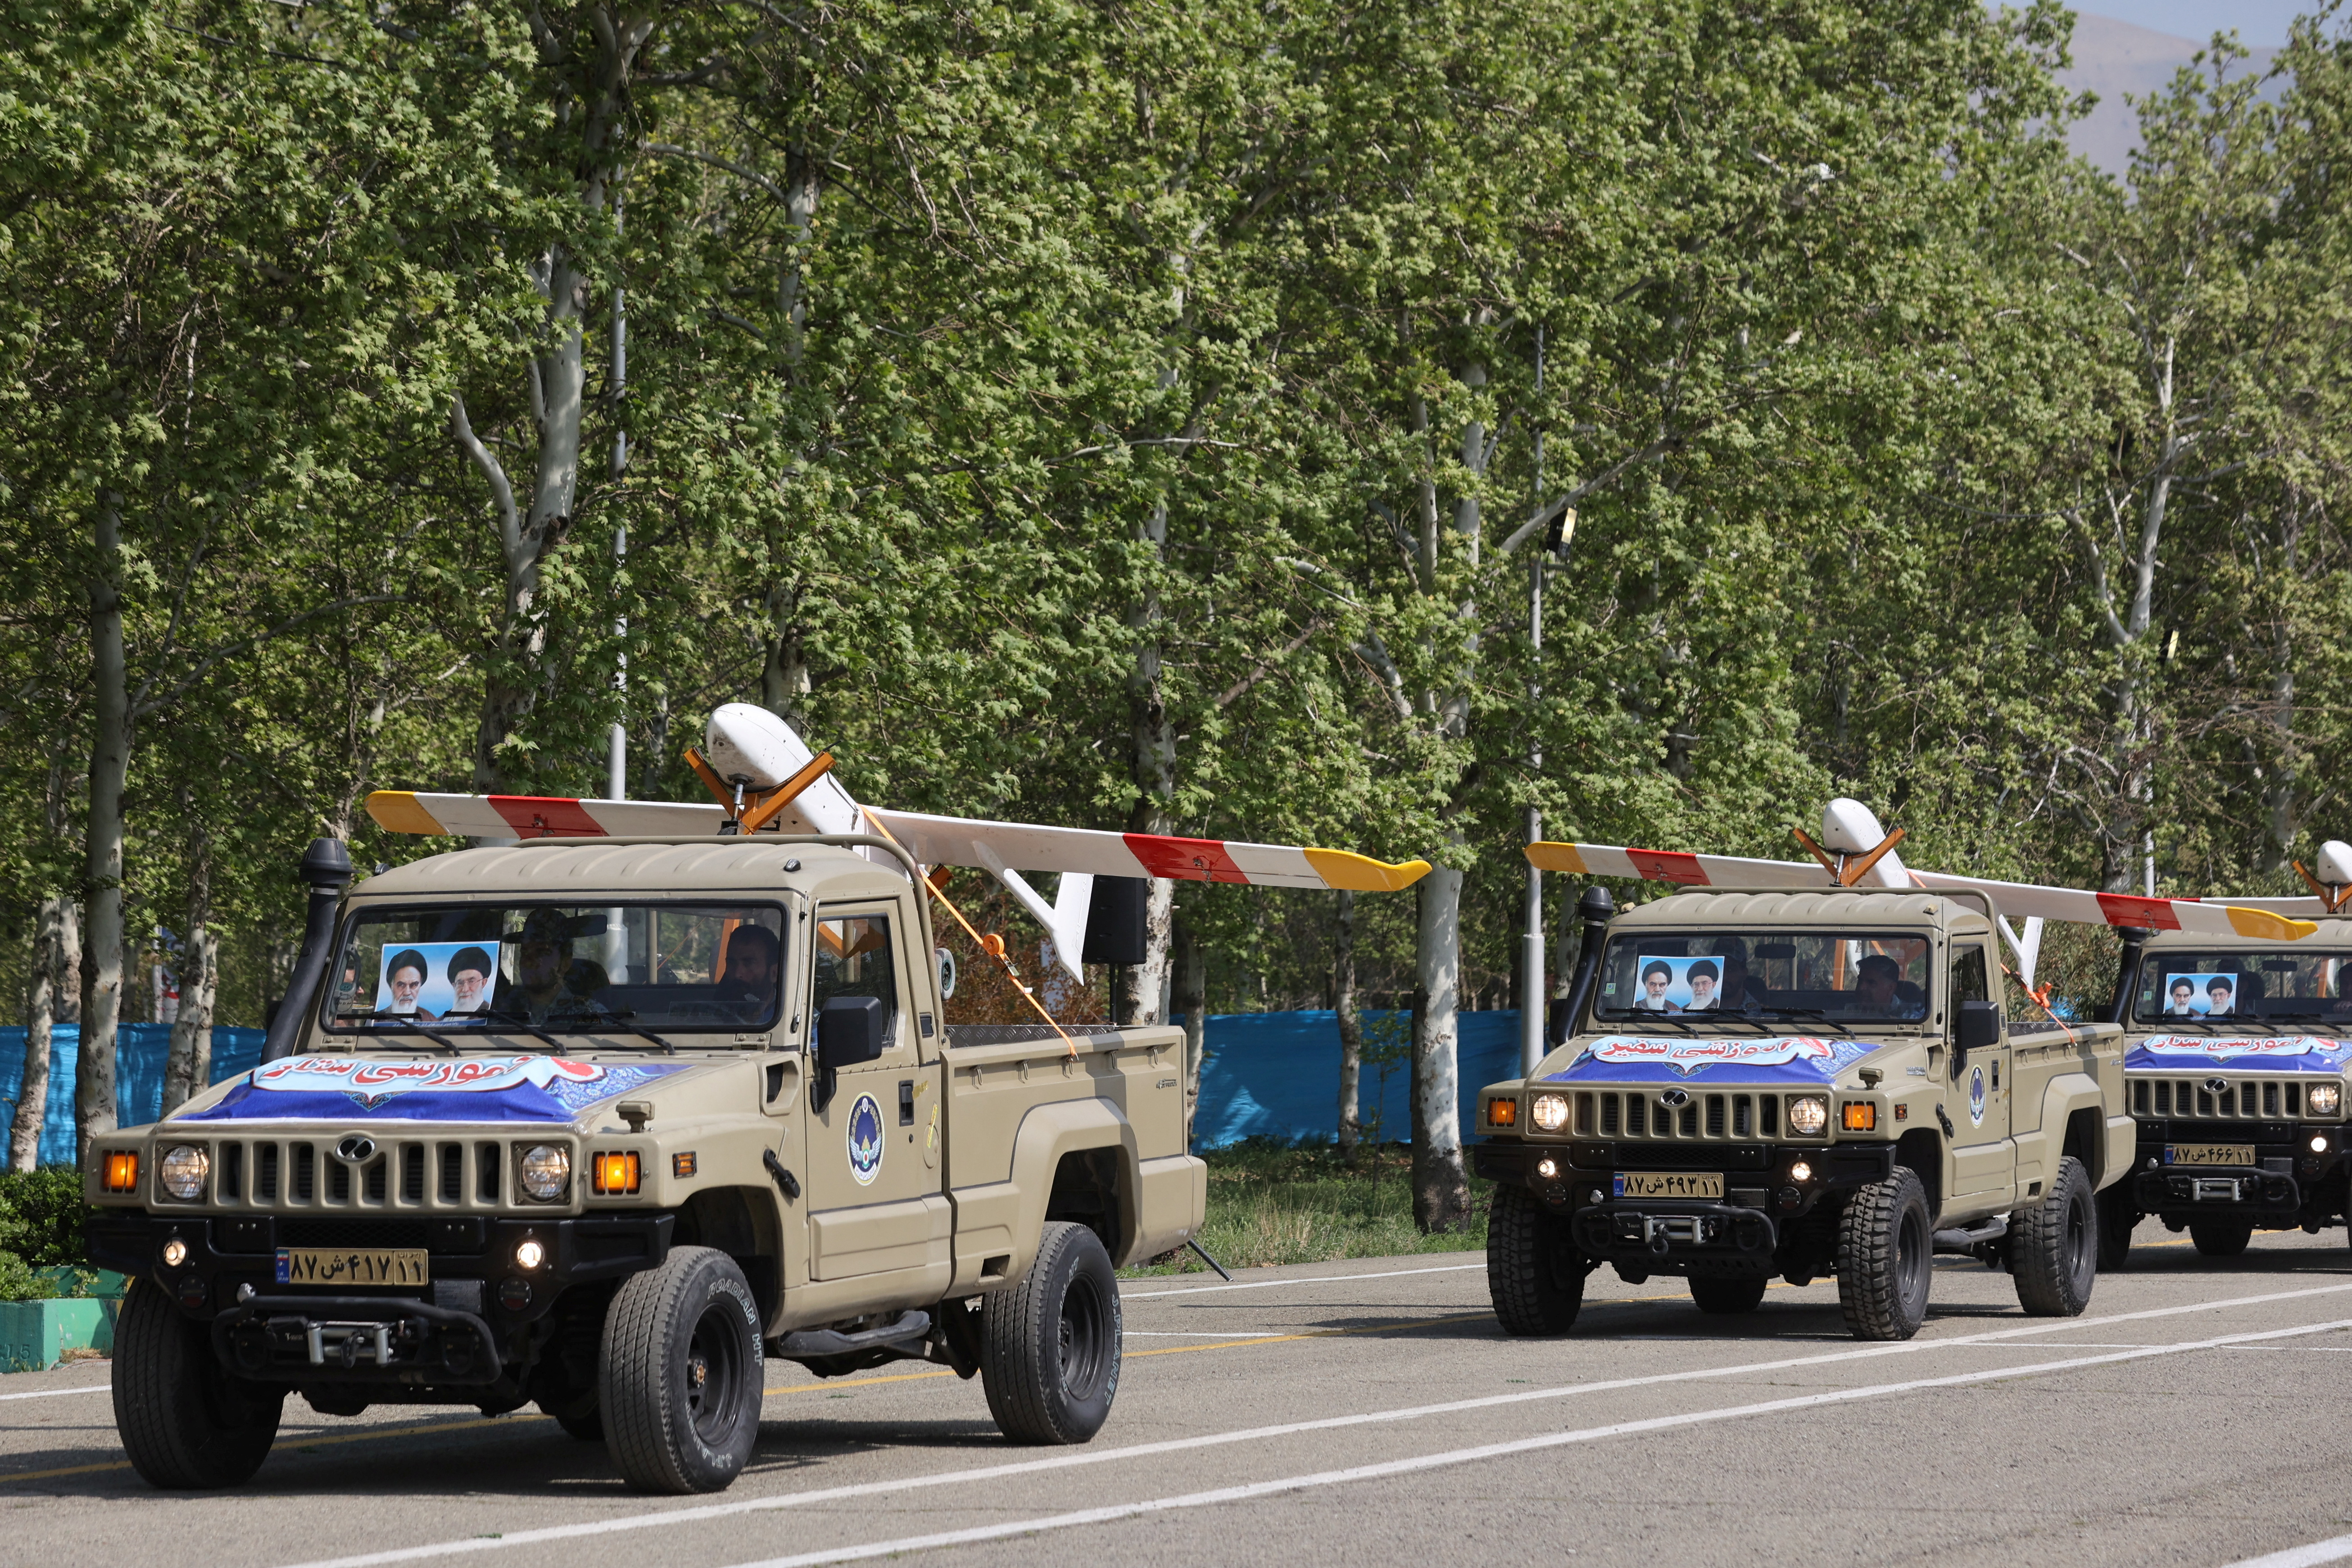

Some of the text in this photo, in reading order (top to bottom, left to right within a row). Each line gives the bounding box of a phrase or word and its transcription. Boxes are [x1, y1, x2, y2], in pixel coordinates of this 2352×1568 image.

[1598, 1039, 1670, 1057] سفیر
[707, 1278, 763, 1367] ROADIAN HT
[1104, 1294, 1121, 1406] J.PLANET
